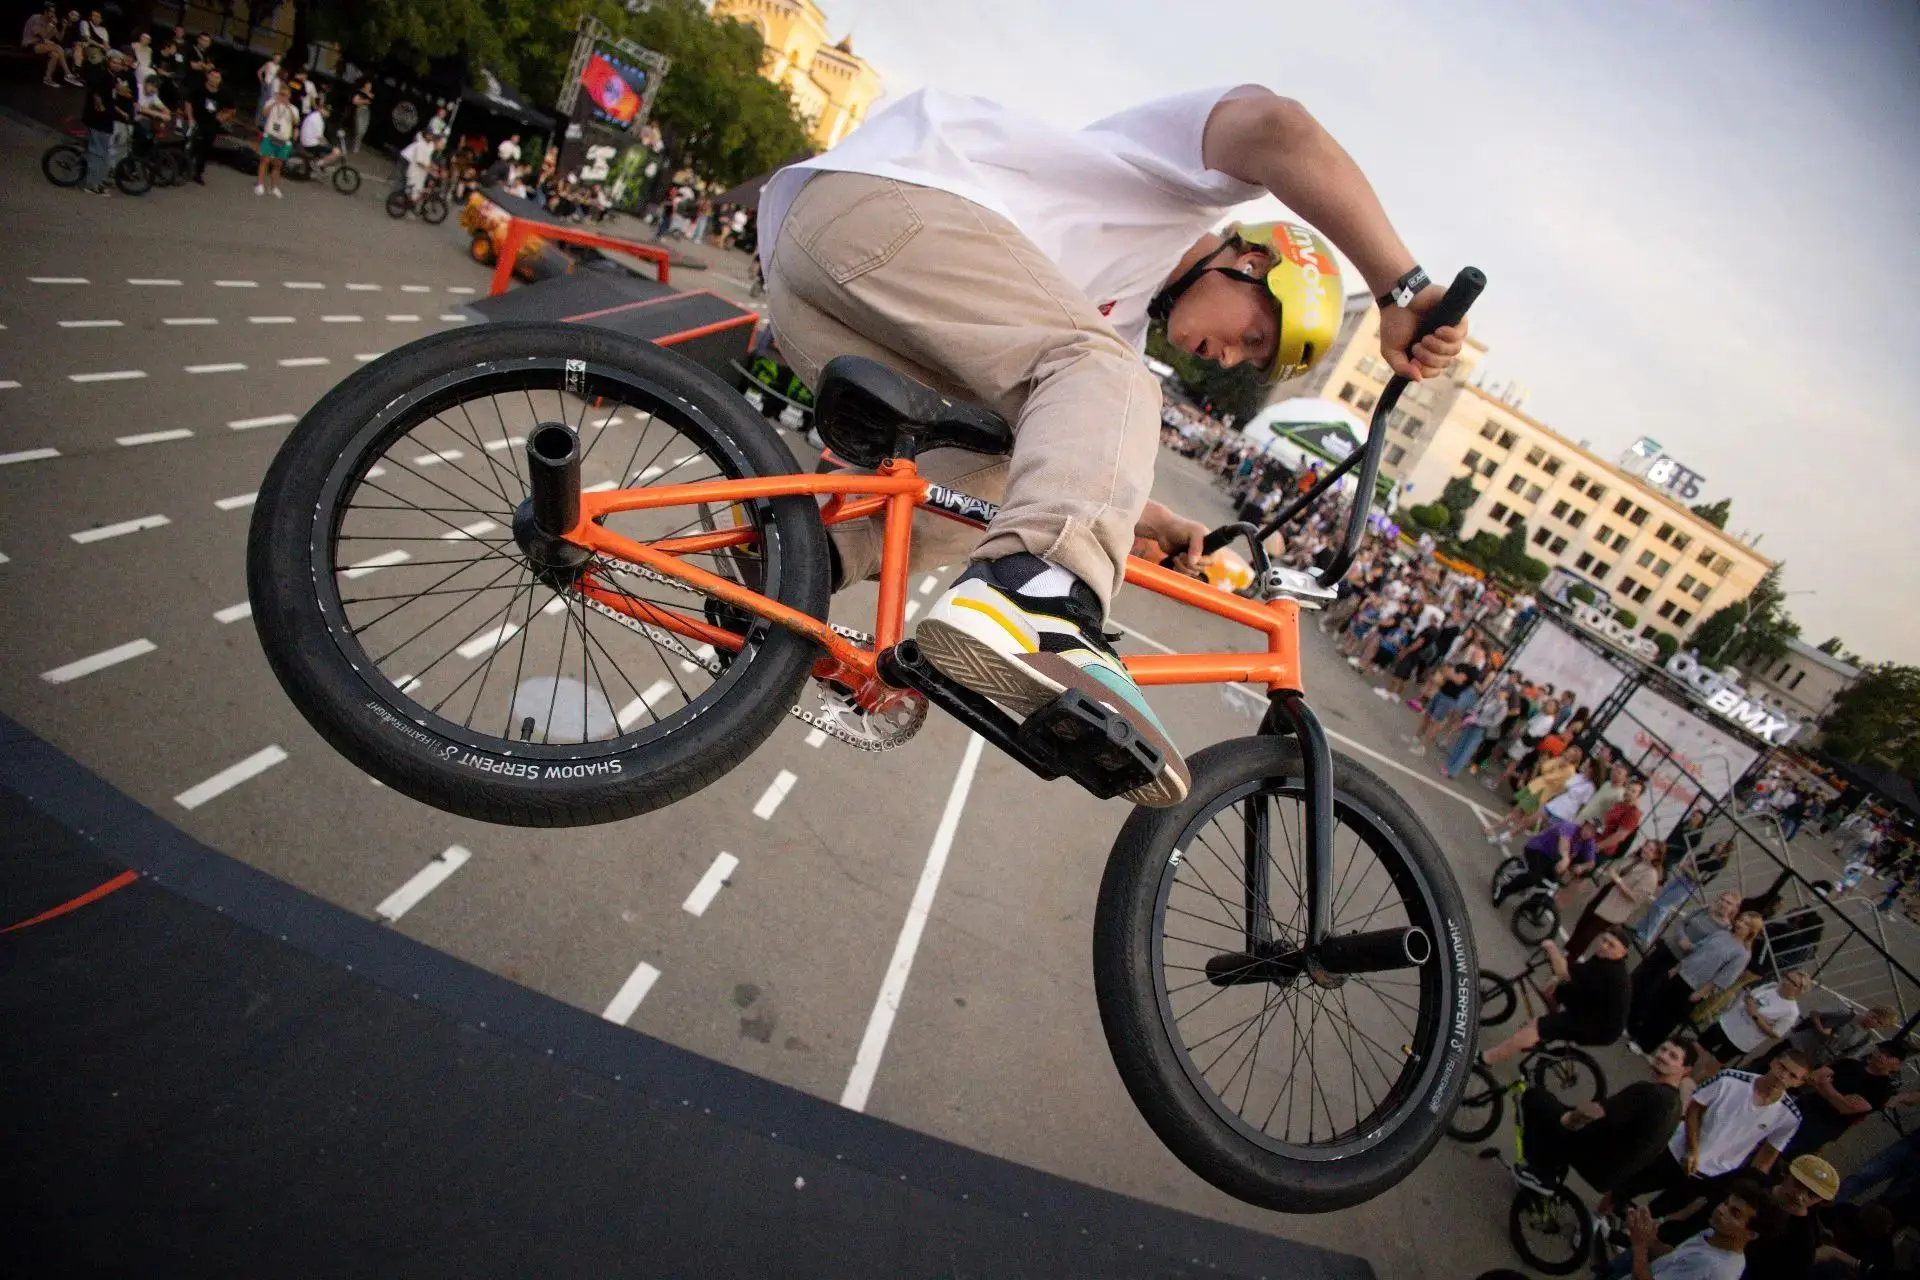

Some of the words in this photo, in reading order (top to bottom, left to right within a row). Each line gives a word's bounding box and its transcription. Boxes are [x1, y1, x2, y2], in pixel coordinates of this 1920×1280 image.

[1291, 227, 1327, 331] invoke
[365, 701, 432, 745] FEATHERWEIGHT
[1707, 688, 1788, 741] BMX
[458, 755, 540, 780] SERPENT
[545, 759, 622, 779] SHADOW
[1453, 978, 1470, 1039] SERPENT
